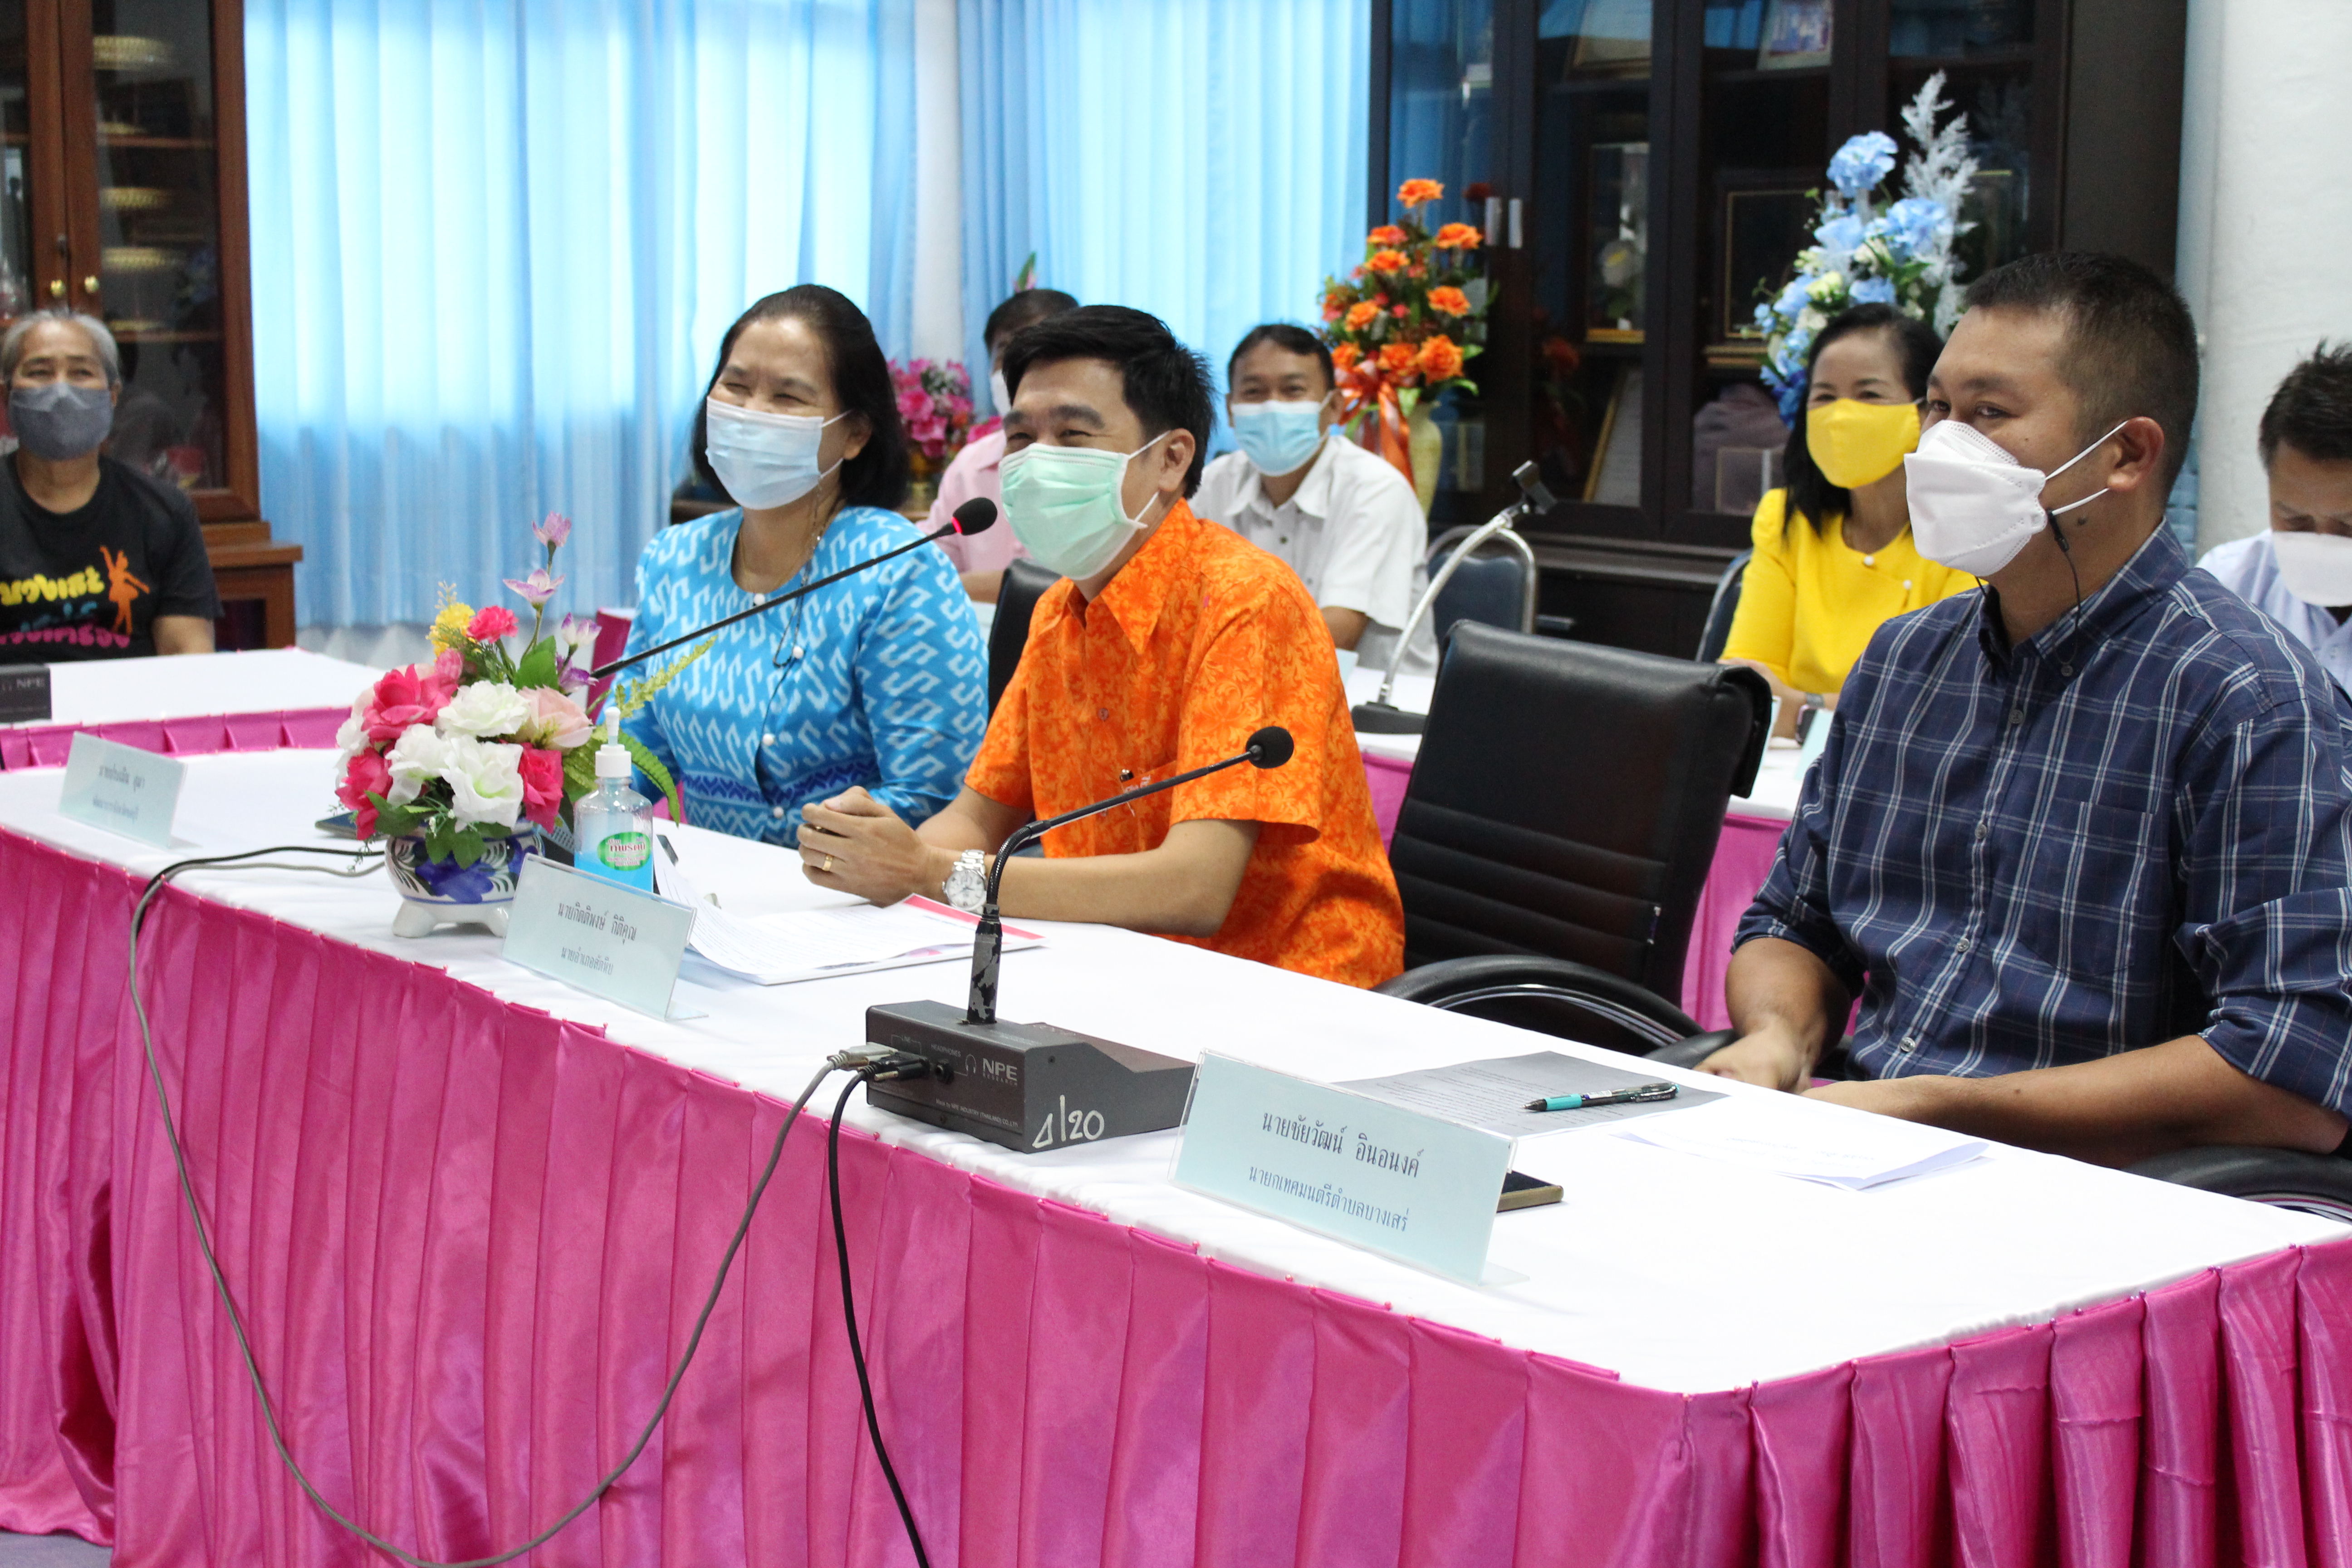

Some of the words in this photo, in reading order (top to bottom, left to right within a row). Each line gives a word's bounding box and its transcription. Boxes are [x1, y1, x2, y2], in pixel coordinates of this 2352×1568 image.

[931, 1044, 961, 1058] HEADPHONES
[983, 1058, 1017, 1081] NPE
[1263, 1112, 1347, 1154] นายชัยวัฒน์
[1356, 1132, 1424, 1178] อินอนงค์
[1249, 1166, 1409, 1232] นายกเทศมนตรีตำบลบางเสร่
